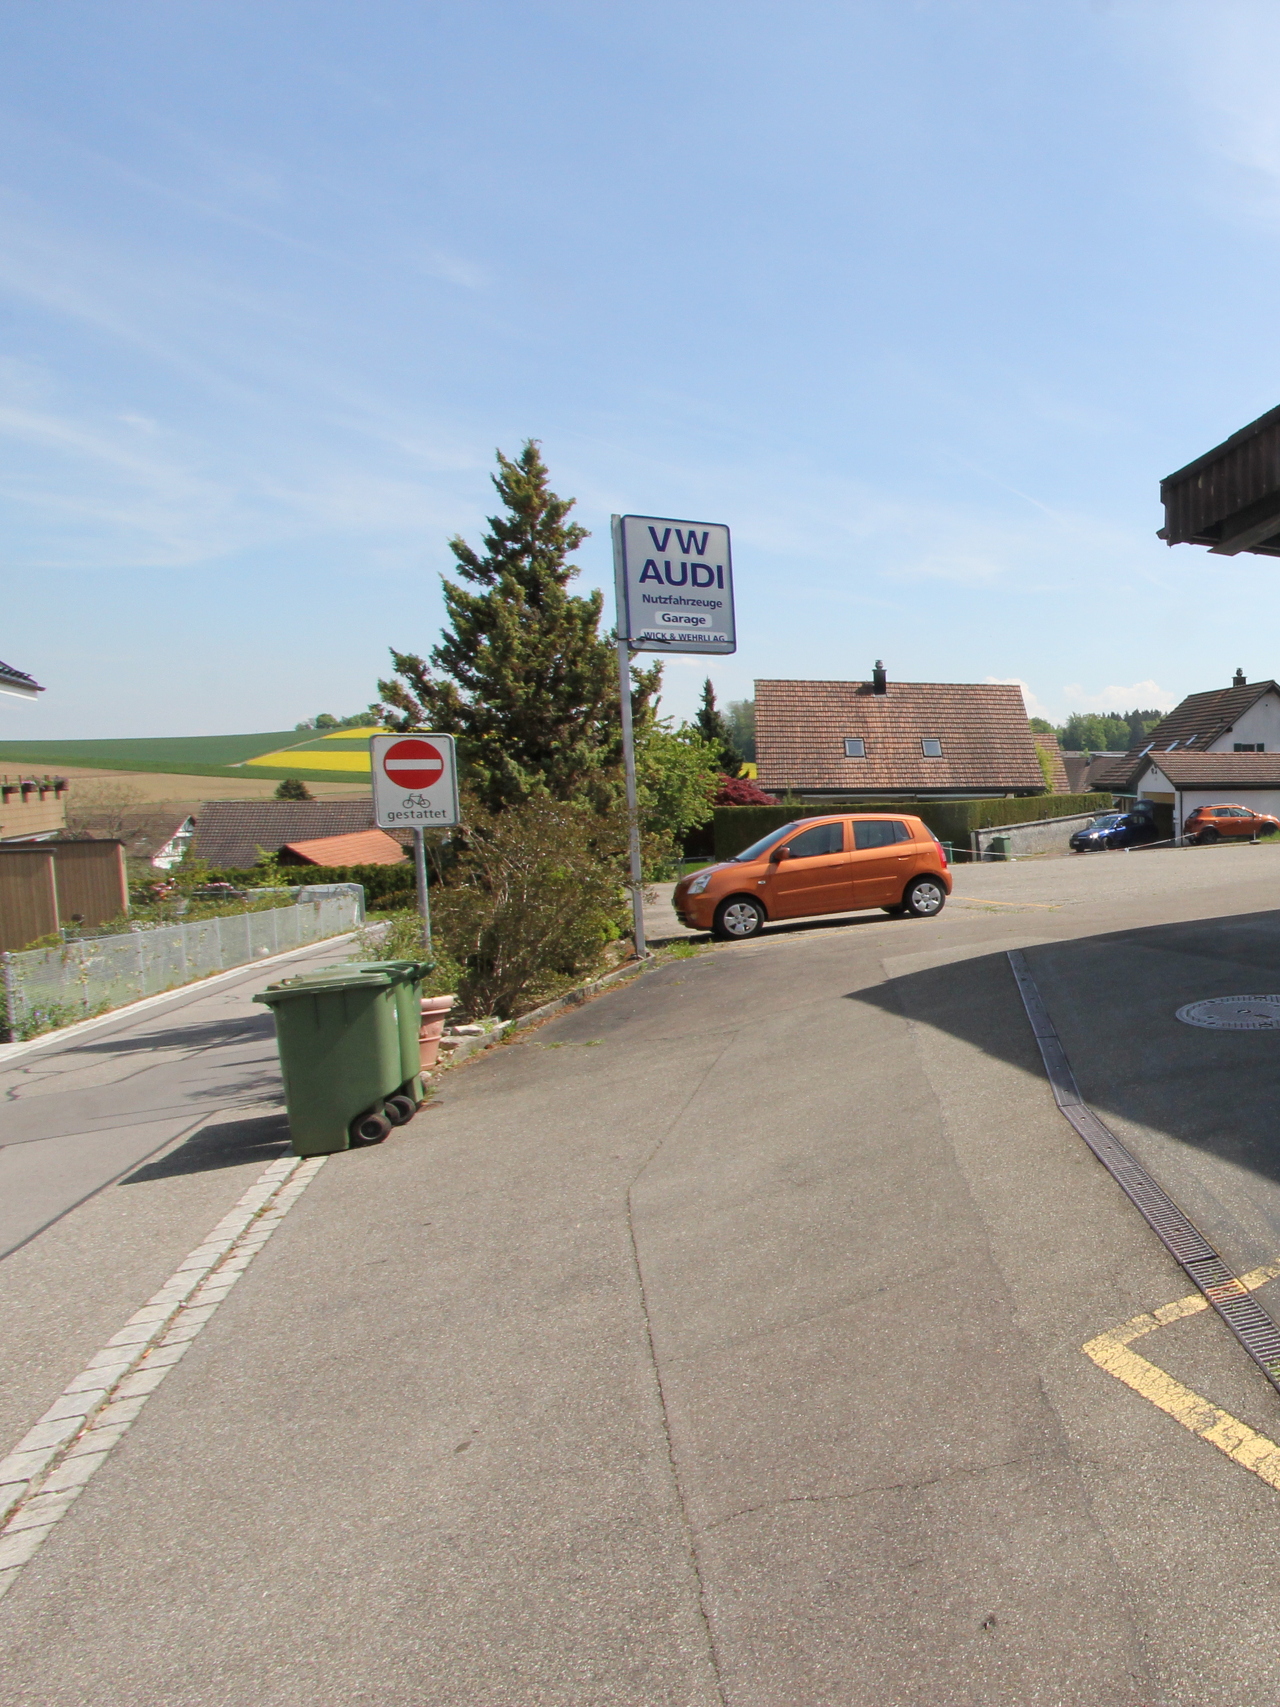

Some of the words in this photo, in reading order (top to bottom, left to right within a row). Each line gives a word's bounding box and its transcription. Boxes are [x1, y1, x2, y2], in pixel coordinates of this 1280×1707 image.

[647, 525, 710, 556] VW
[638, 558, 725, 590] AUDI
[641, 593, 723, 610] Nutzfahrzeuge
[661, 612, 706, 627] Garage
[643, 631, 668, 641] WICK
[669, 632, 676, 640] &
[712, 634, 726, 643] AG
[387, 809, 447, 823] gestattet
